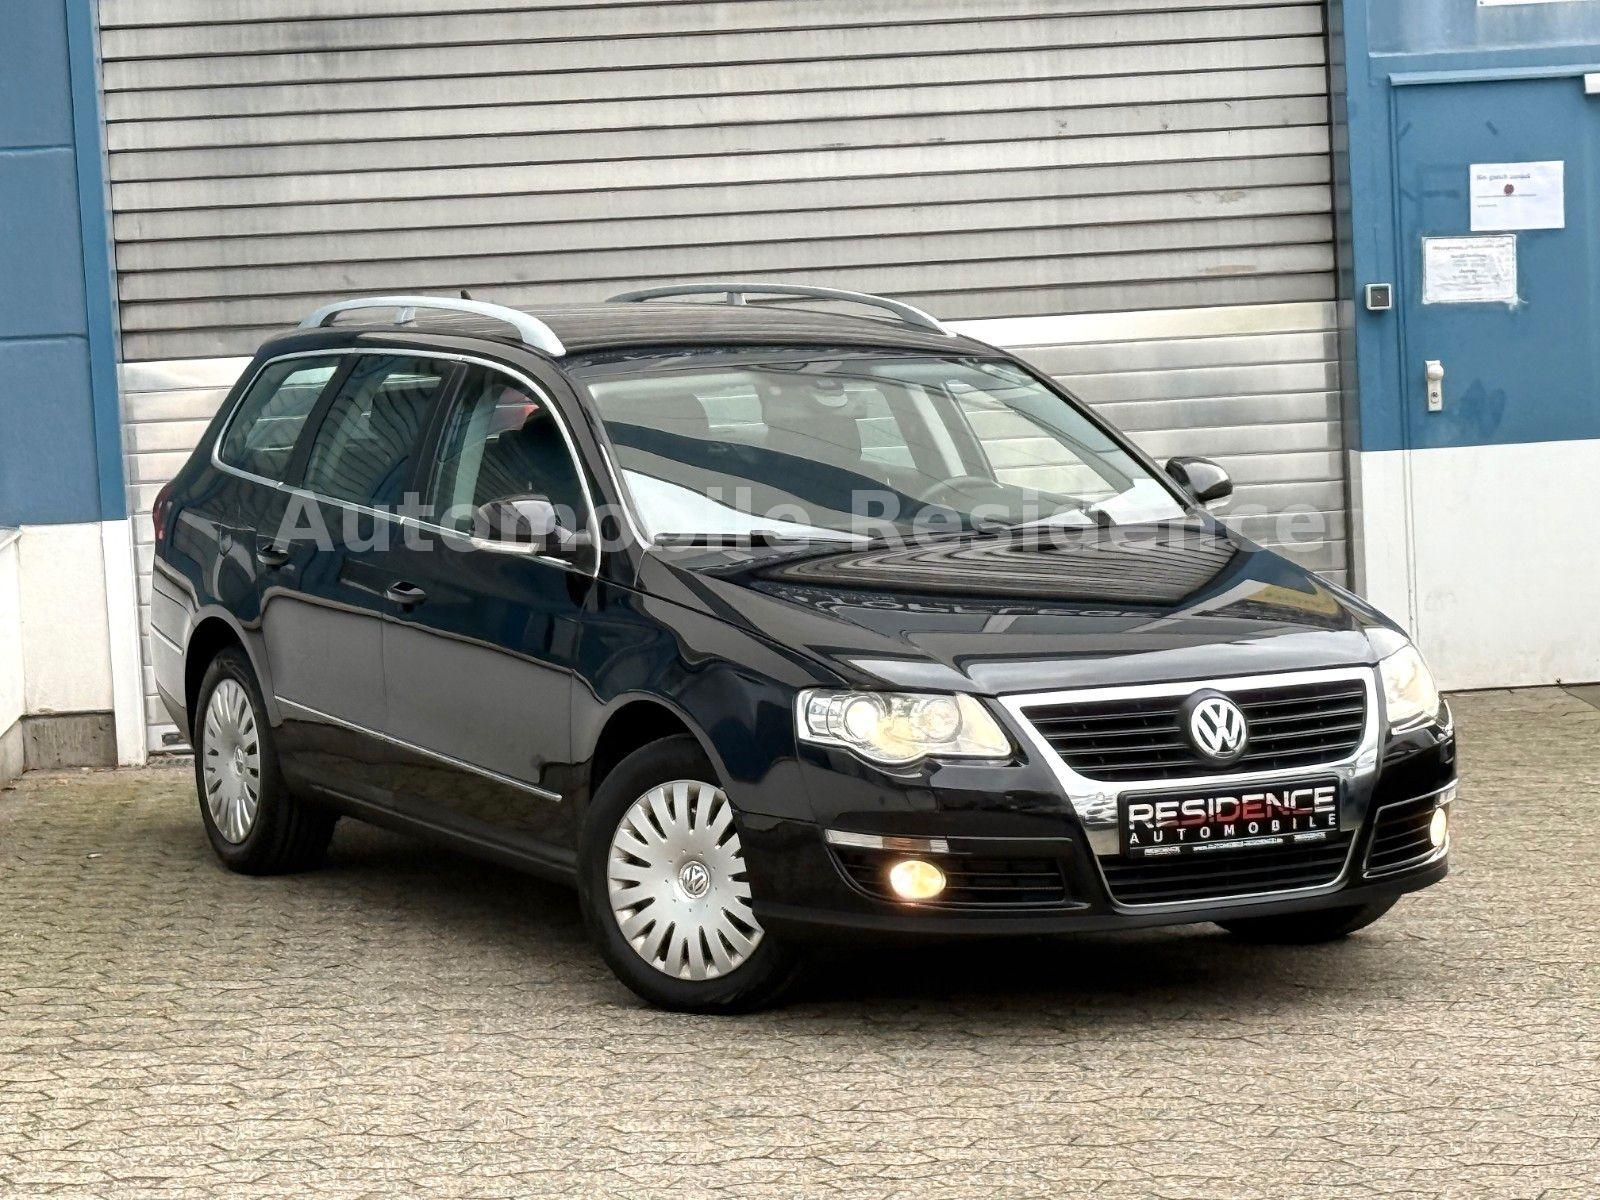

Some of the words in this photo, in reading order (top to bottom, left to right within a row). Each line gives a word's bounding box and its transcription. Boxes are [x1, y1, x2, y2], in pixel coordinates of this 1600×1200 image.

[1191, 698, 1247, 758] VW
[1128, 786, 1336, 830] RESIDENCE
[1129, 813, 1336, 845] AUTOMOBILE
